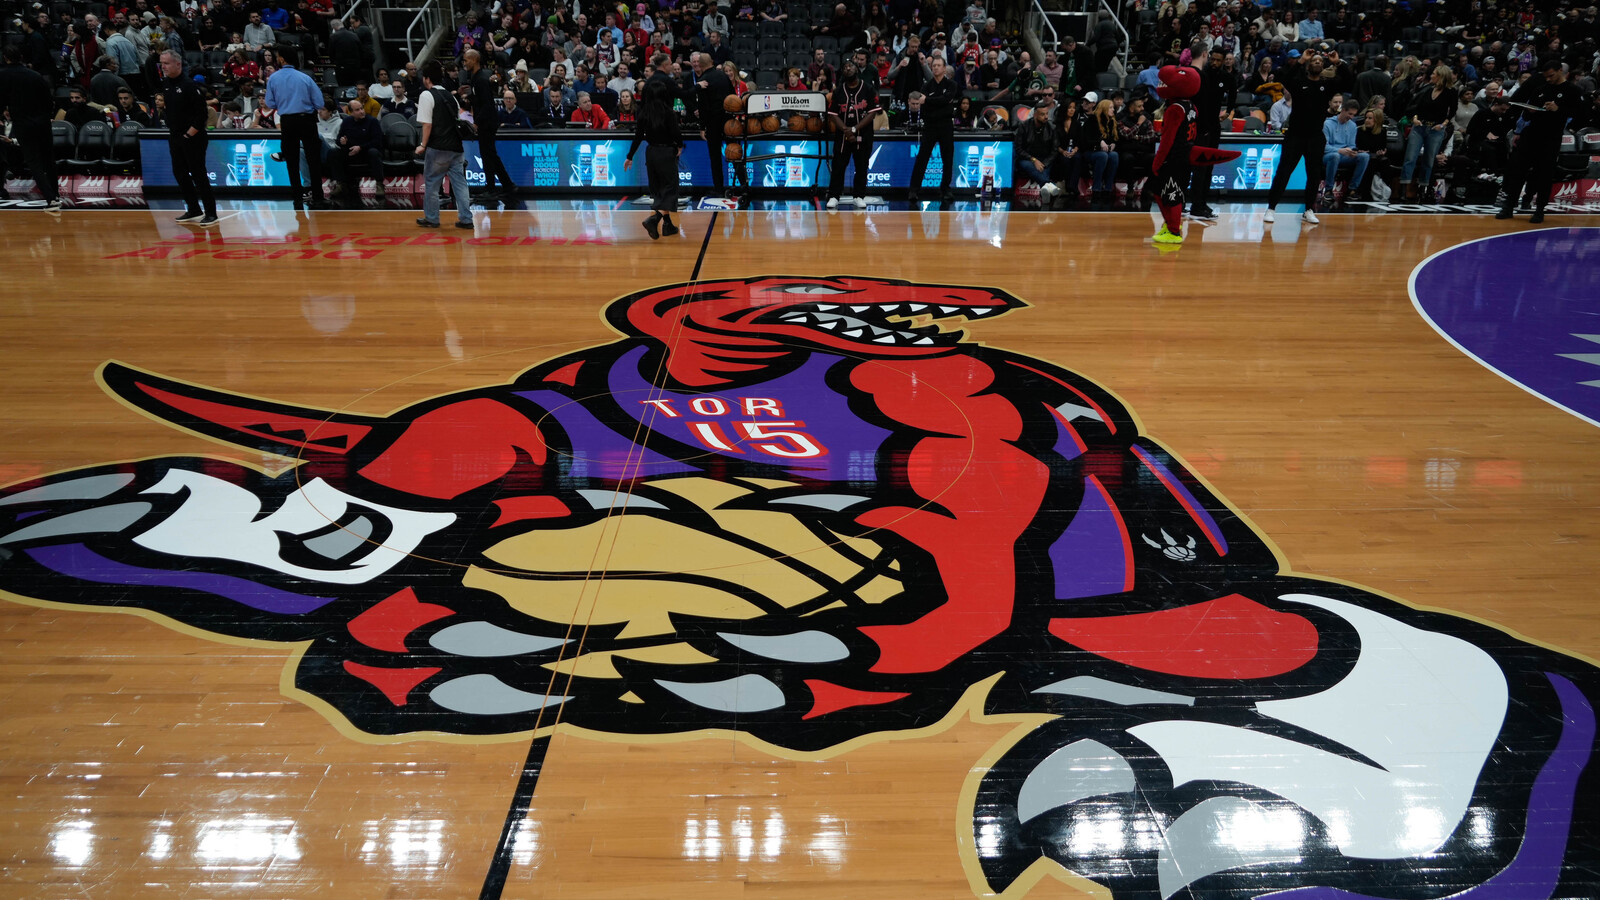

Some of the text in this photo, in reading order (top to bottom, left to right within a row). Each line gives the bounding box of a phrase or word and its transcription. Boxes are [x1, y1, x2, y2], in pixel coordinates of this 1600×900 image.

[781, 96, 810, 105] Wilson
[521, 143, 559, 157] NEW
[465, 170, 486, 182] Deg
[867, 172, 891, 183] gree
[921, 179, 942, 187] BOD
[152, 232, 616, 246] Scotiabank
[100, 246, 386, 260] Arena
[638, 397, 786, 419] TOR
[685, 420, 829, 459] 15
